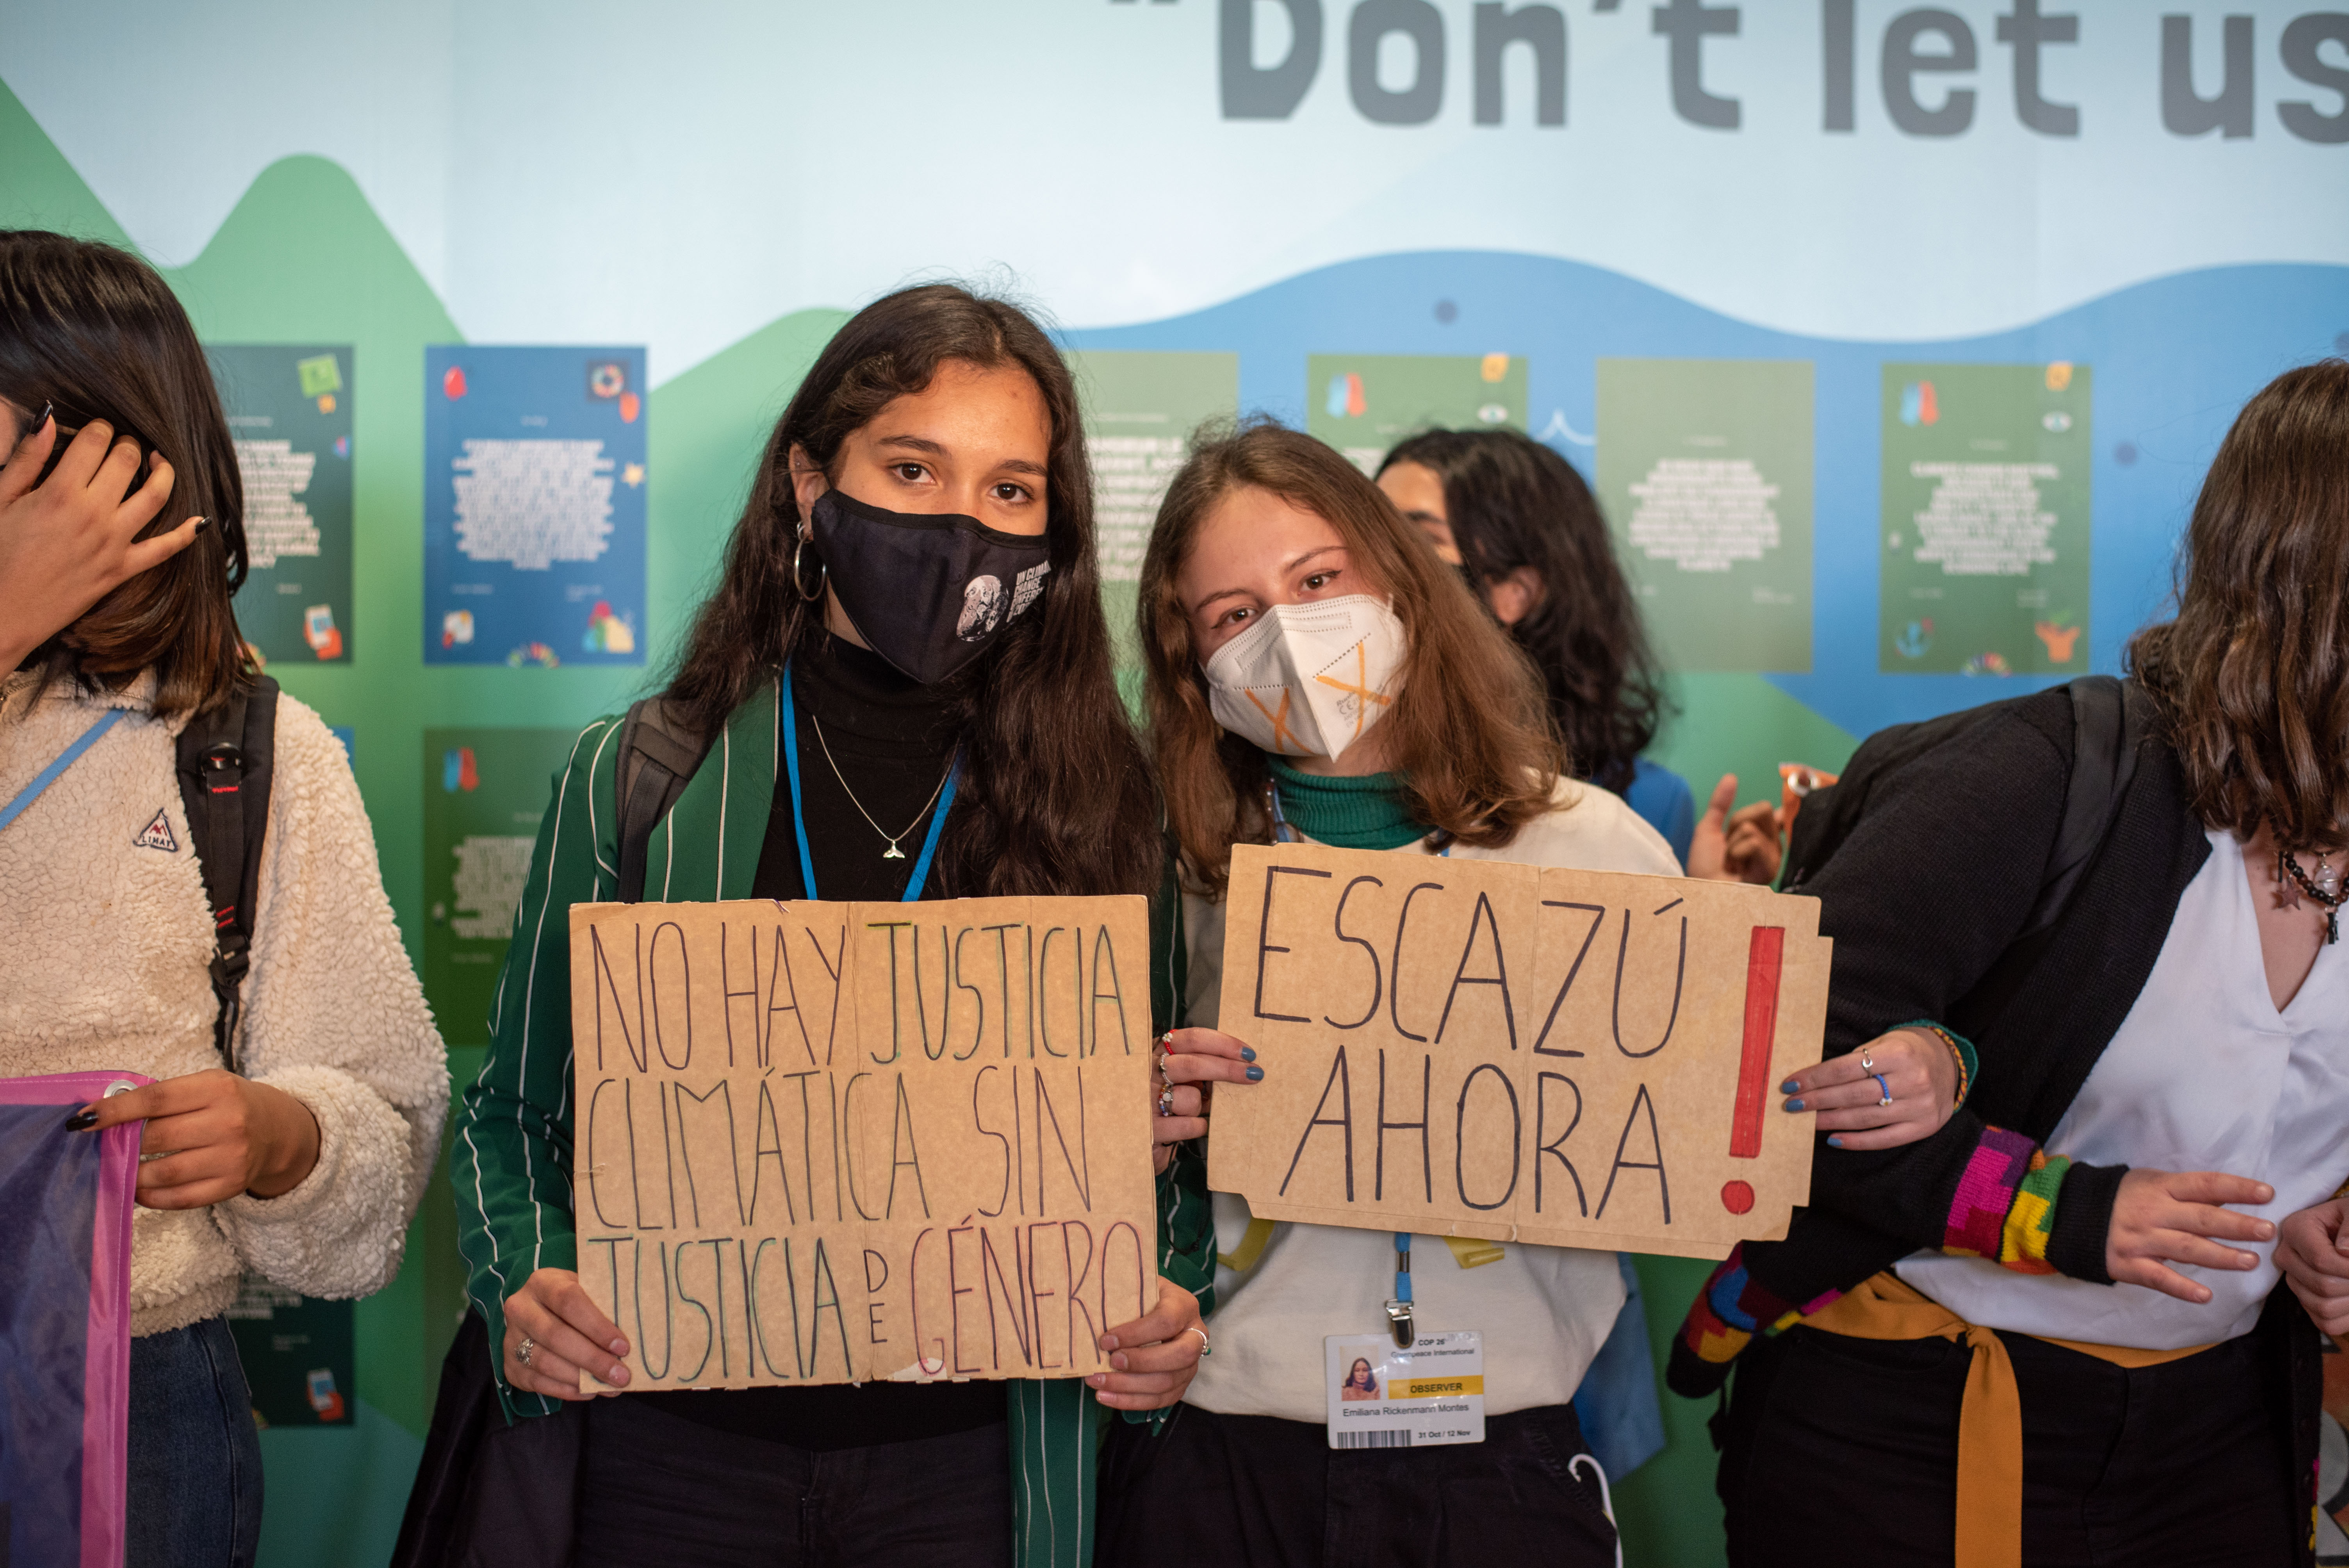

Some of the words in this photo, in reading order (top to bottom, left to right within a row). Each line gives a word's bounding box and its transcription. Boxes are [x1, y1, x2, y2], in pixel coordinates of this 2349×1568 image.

[1821, 0, 2080, 139] let
[2160, 11, 2349, 145] us
[142, 836, 171, 846] LIMAY
[591, 922, 693, 1073] NO
[722, 921, 846, 1069] HAY
[868, 922, 1131, 1064] JUSTICIA
[1253, 864, 1688, 1059] ESCAZÚ
[588, 1067, 931, 1230] CLIMÁTICA
[973, 1065, 1092, 1218] SIN
[1279, 1044, 1671, 1226] AHORA
[588, 1237, 853, 1383] JUSTICIA
[864, 1249, 889, 1344] DE
[911, 1215, 1144, 1376] GÉNERO
[1391, 1350, 1432, 1358] Greenpeace
[1343, 1408, 1380, 1417] Emiliana
[1383, 1406, 1436, 1415] Rickenmann
[1438, 1404, 1469, 1412] Montes
[1410, 1383, 1463, 1393] OBSERVER
